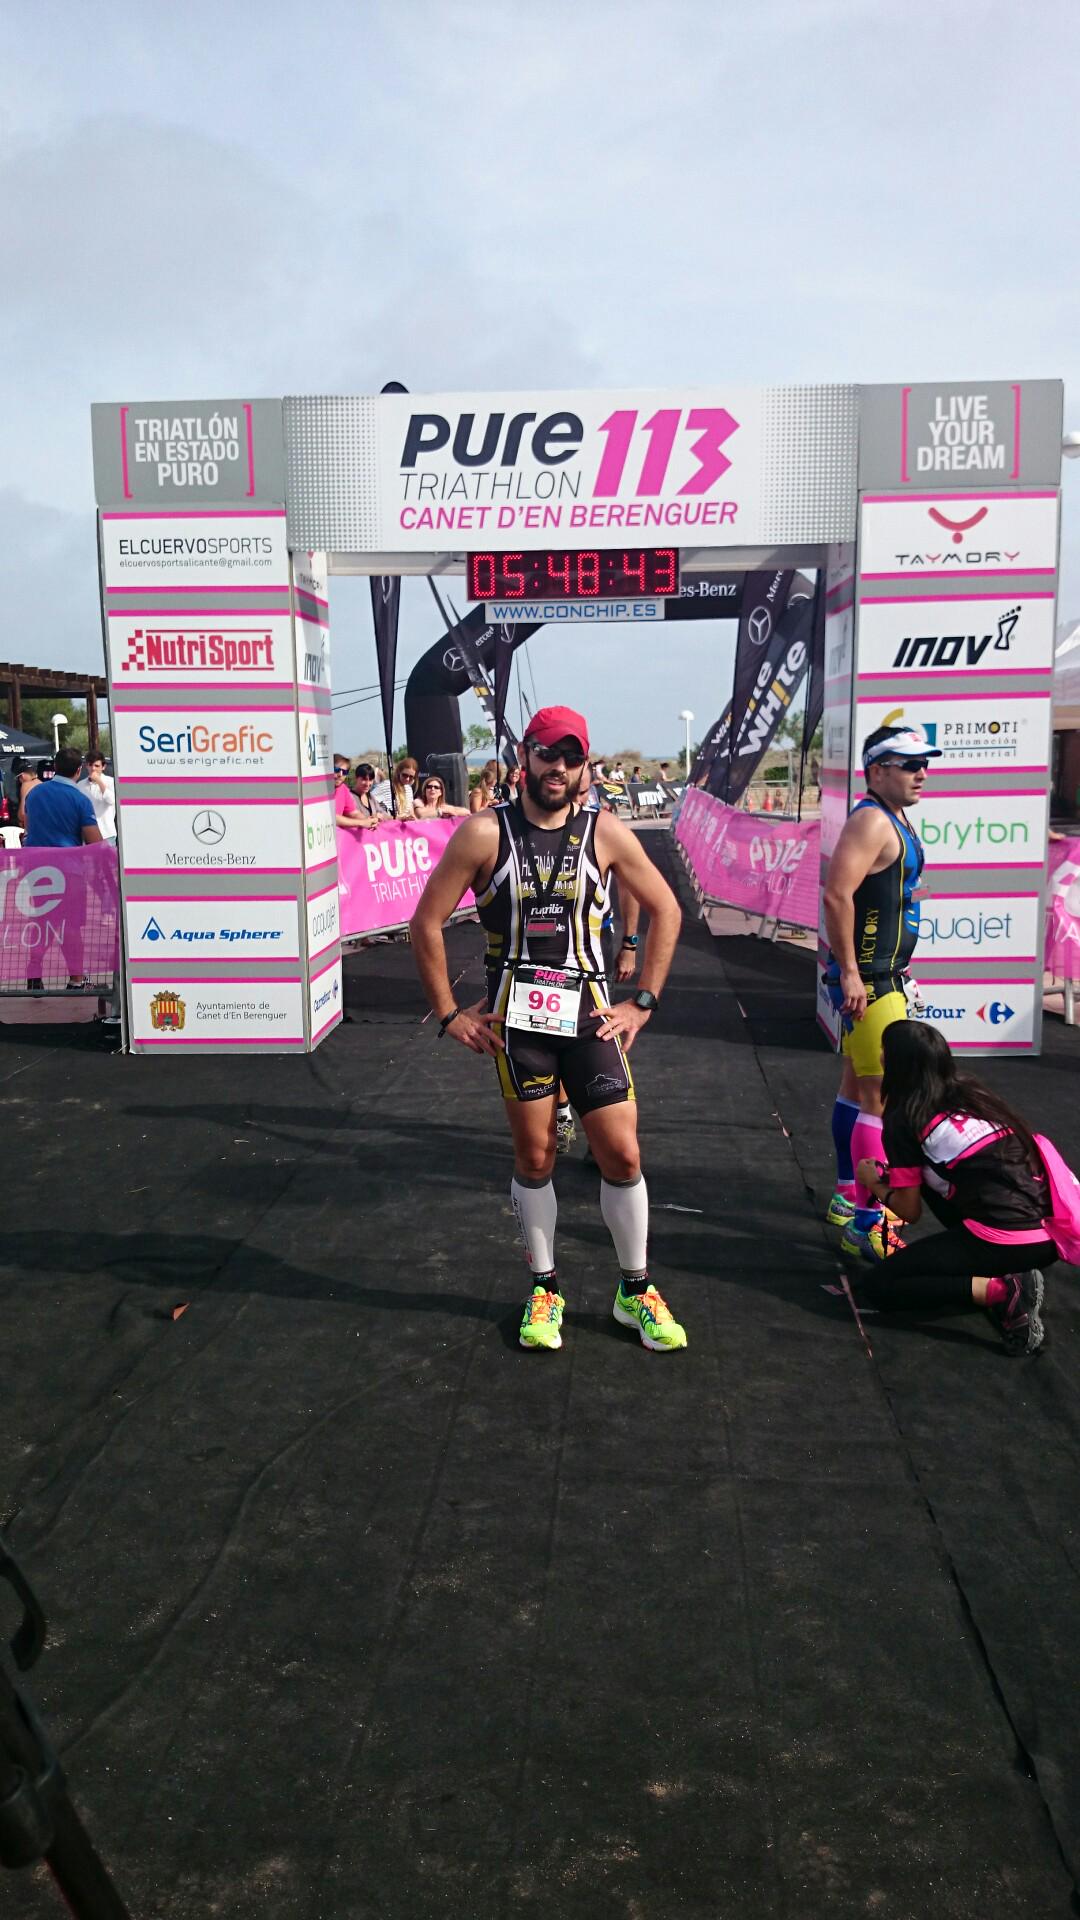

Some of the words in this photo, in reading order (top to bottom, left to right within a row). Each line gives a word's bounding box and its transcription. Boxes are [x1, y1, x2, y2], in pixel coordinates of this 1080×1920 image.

[935, 396, 988, 421] LIVE
[135, 412, 238, 441] TRIATLÓN
[928, 421, 994, 446] YOUR
[135, 442, 159, 463] EN
[166, 440, 240, 461] ESTADO
[592, 408, 741, 498] 113
[917, 445, 1005, 471] DREAM
[157, 462, 219, 486] PURO
[400, 470, 582, 500] TRIATHLON
[400, 506, 492, 530] CANET
[499, 504, 562, 529] D'EN
[569, 502, 738, 528] BERENGUER
[119, 557, 273, 569] elcuervosportsalicante@gmail.com
[895, 551, 1020, 566] TAYMORY
[473, 549, 676, 598] 05:48:43
[493, 603, 657, 621] WWW.CONCHIP.ES
[146, 634, 273, 669] NutriSport
[139, 725, 273, 753] SeriGrafic
[944, 721, 1018, 735] PRIMOTI
[147, 756, 264, 767] www.serigrafic.net
[921, 817, 1028, 850] bryton
[165, 853, 256, 865] Mercedes-Benz
[170, 930, 215, 942] Aqua
[219, 928, 281, 941] Sphere
[196, 1001, 255, 1011] Ayuntamiento
[257, 1001, 270, 1010] de
[528, 990, 561, 1013] 96
[196, 1011, 221, 1020] Canet
[244, 1011, 287, 1022] Berenguer
